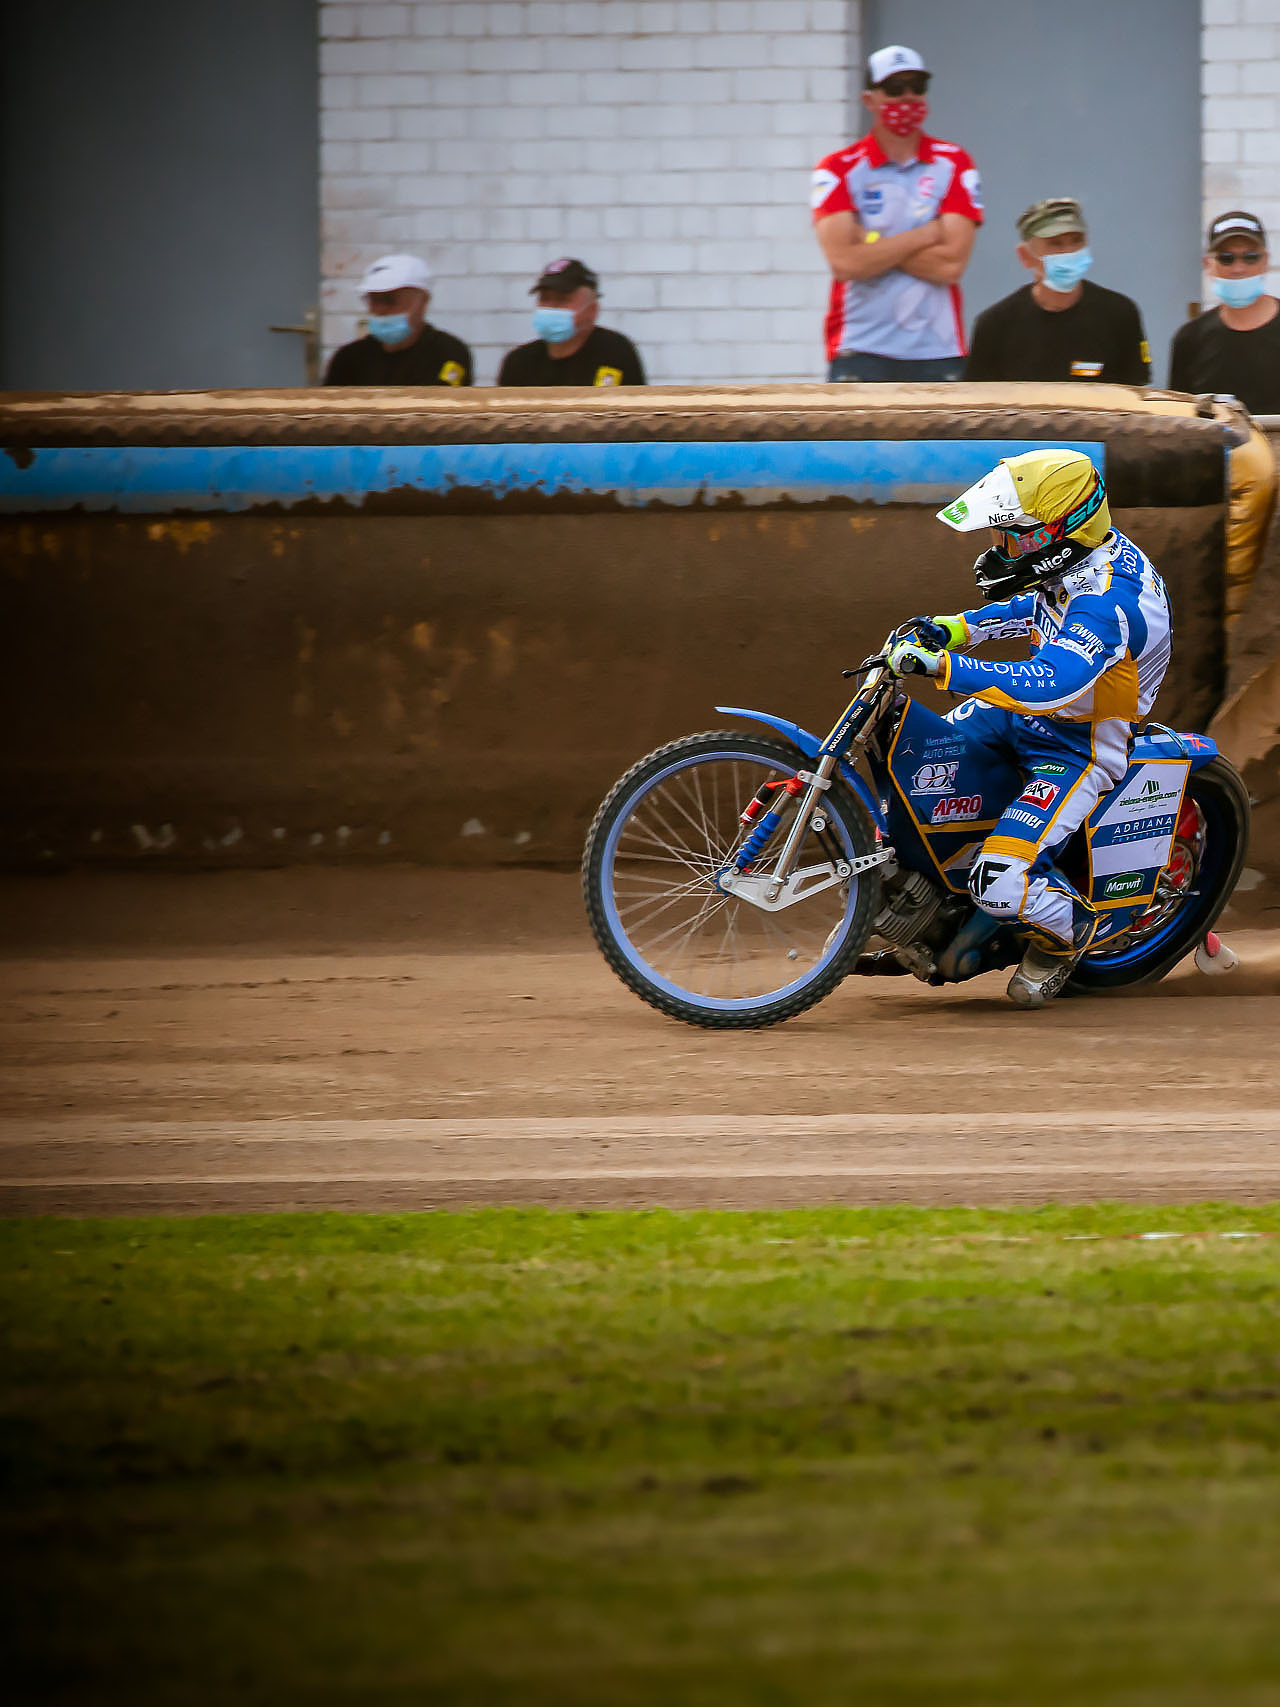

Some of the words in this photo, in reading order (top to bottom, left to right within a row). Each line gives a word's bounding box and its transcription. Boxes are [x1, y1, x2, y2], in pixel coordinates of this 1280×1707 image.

[989, 512, 1015, 525] Nice
[1032, 547, 1072, 575] Nice
[958, 655, 1054, 678] NICOLAUS
[1012, 679, 1057, 688] BANK
[933, 795, 982, 817] APRO
[1114, 816, 1172, 834] ADRIANA
[1106, 877, 1142, 892] Marwit
